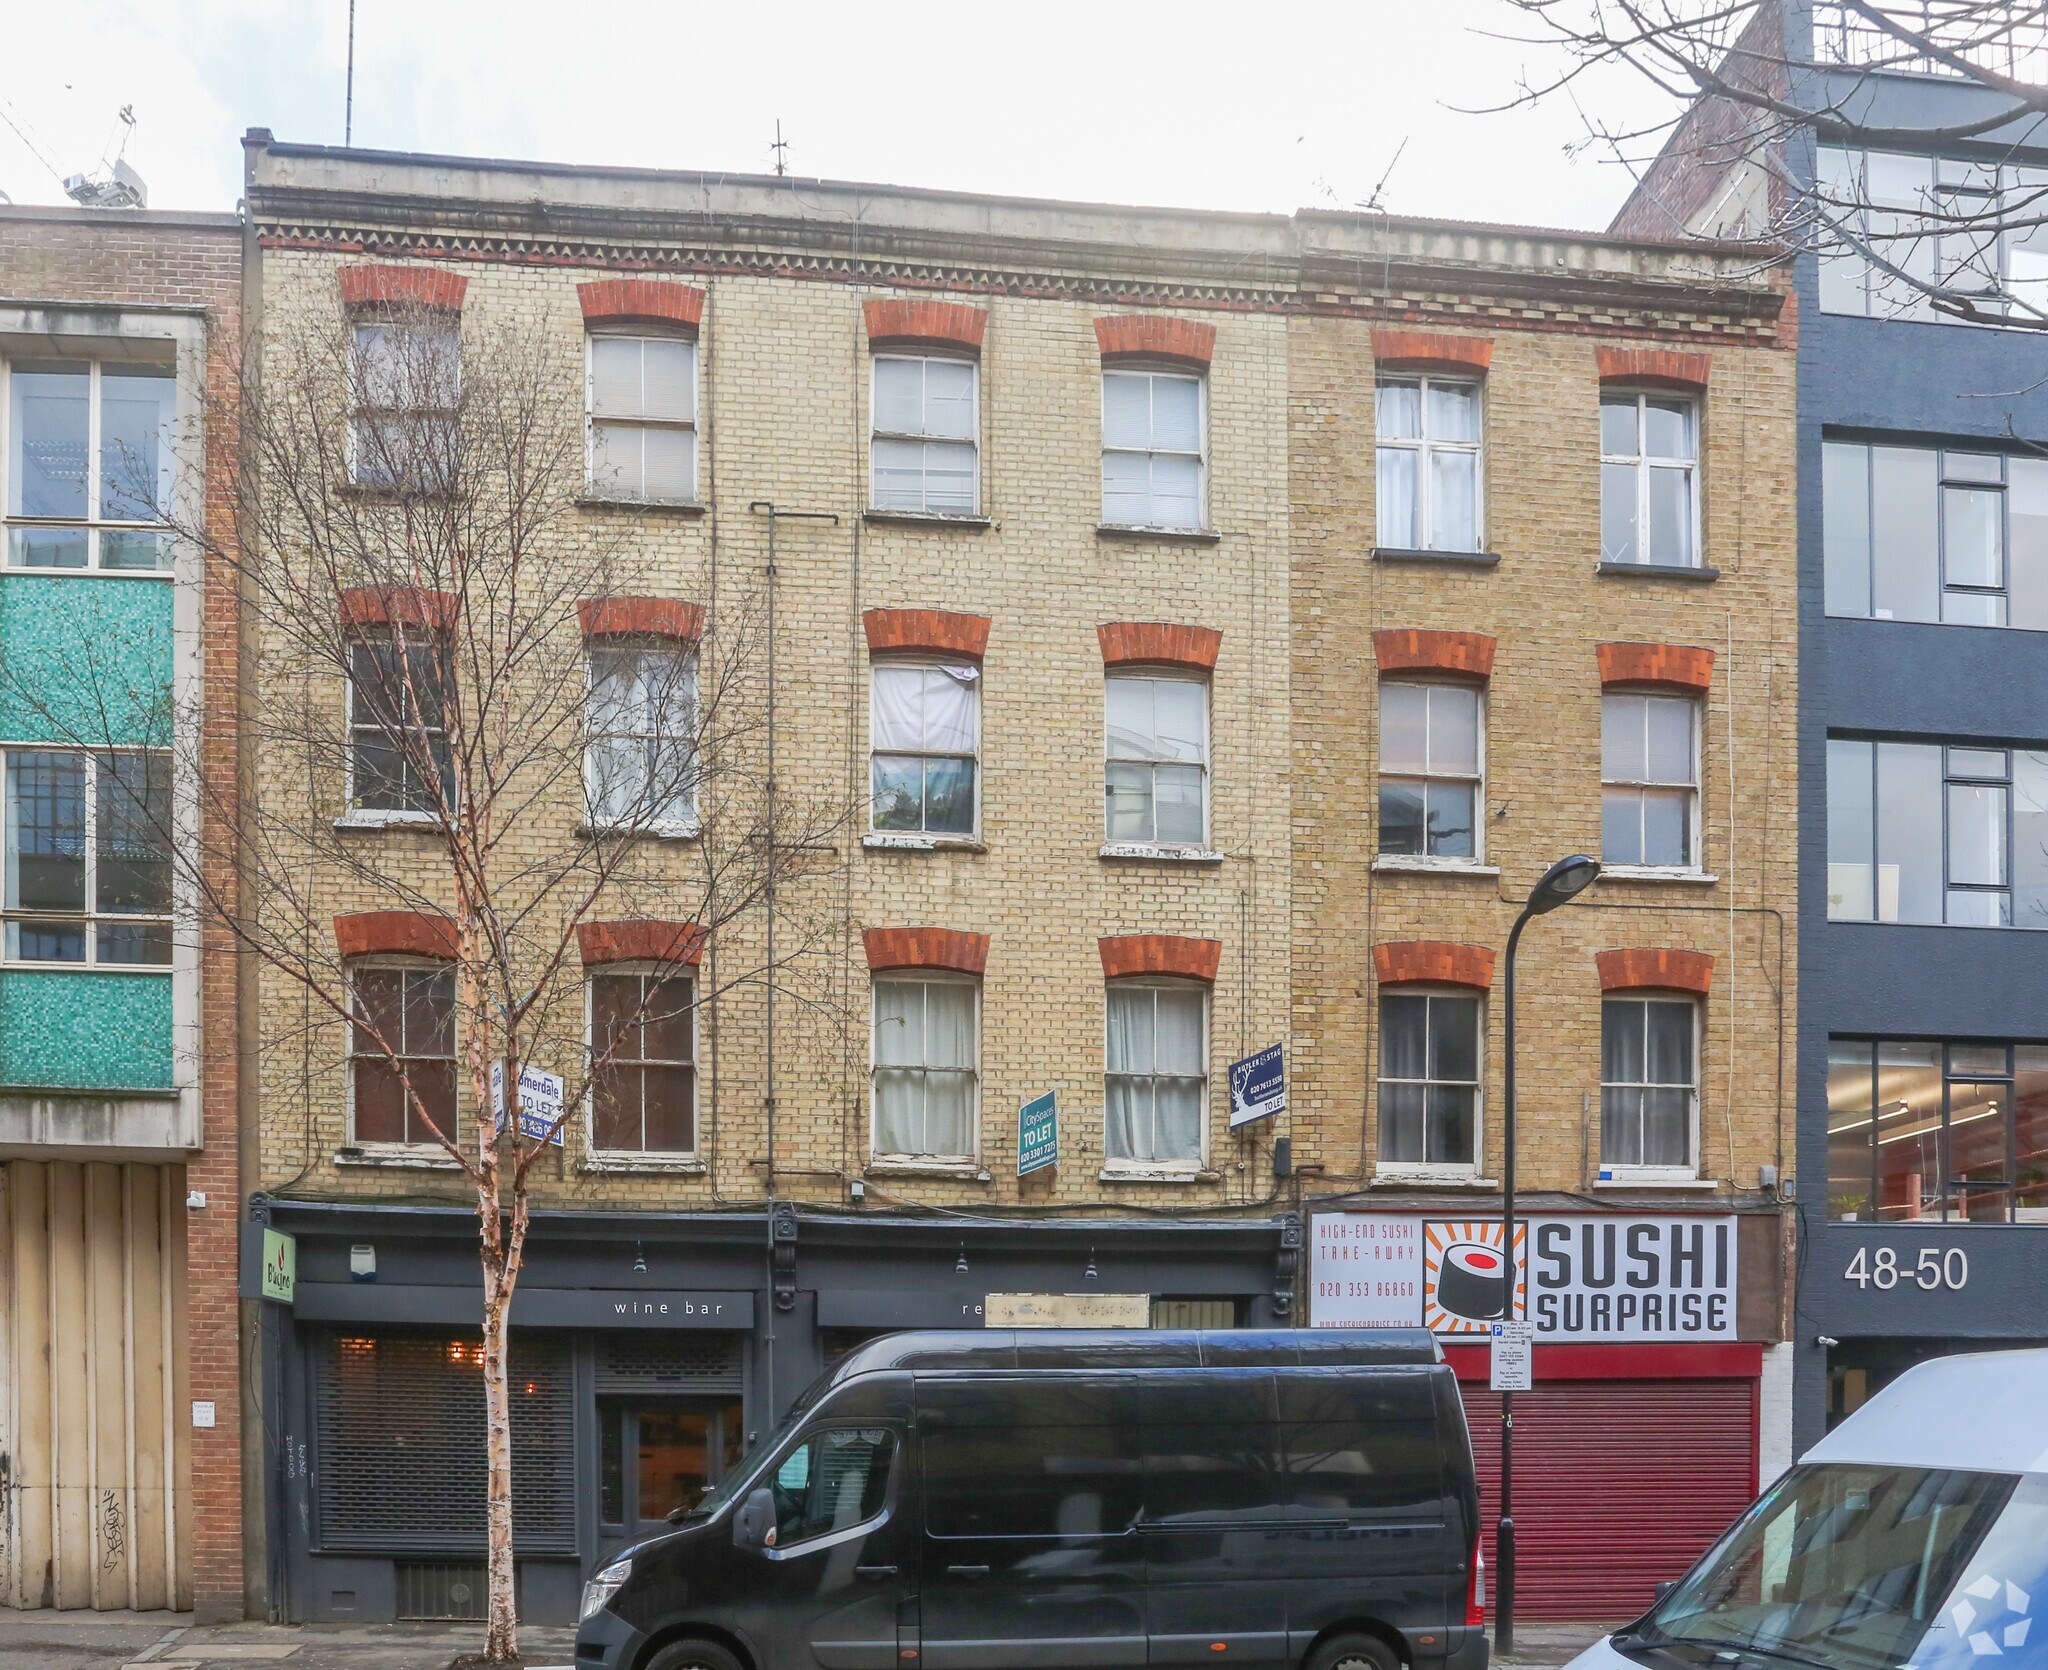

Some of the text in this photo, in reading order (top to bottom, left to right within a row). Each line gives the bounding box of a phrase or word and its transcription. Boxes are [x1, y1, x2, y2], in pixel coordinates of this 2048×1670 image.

[1237, 1059, 1259, 1074] BUTLER
[1266, 1048, 1281, 1062] STAG
[517, 1074, 559, 1099] omerdale
[521, 1095, 553, 1116] TO LET
[1264, 1096, 1283, 1112] TO LET
[1026, 1107, 1054, 1126] CitySpaces
[1023, 1123, 1052, 1148] TO LET
[1020, 1151, 1029, 1163] 020
[1030, 1147, 1043, 1160] 3301
[1320, 1224, 1413, 1239] HIGH-END SUSHI
[1321, 1245, 1414, 1260] TAKE-AWAY
[1537, 1223, 1728, 1289] SUSHI
[1844, 1247, 1968, 1290] 48-50
[1320, 1282, 1414, 1297] 020 353 86860
[614, 1301, 722, 1314] wine bar
[962, 1304, 982, 1314] re
[1537, 1293, 1727, 1332] SURPRISE
[1494, 1325, 1502, 1336] P
